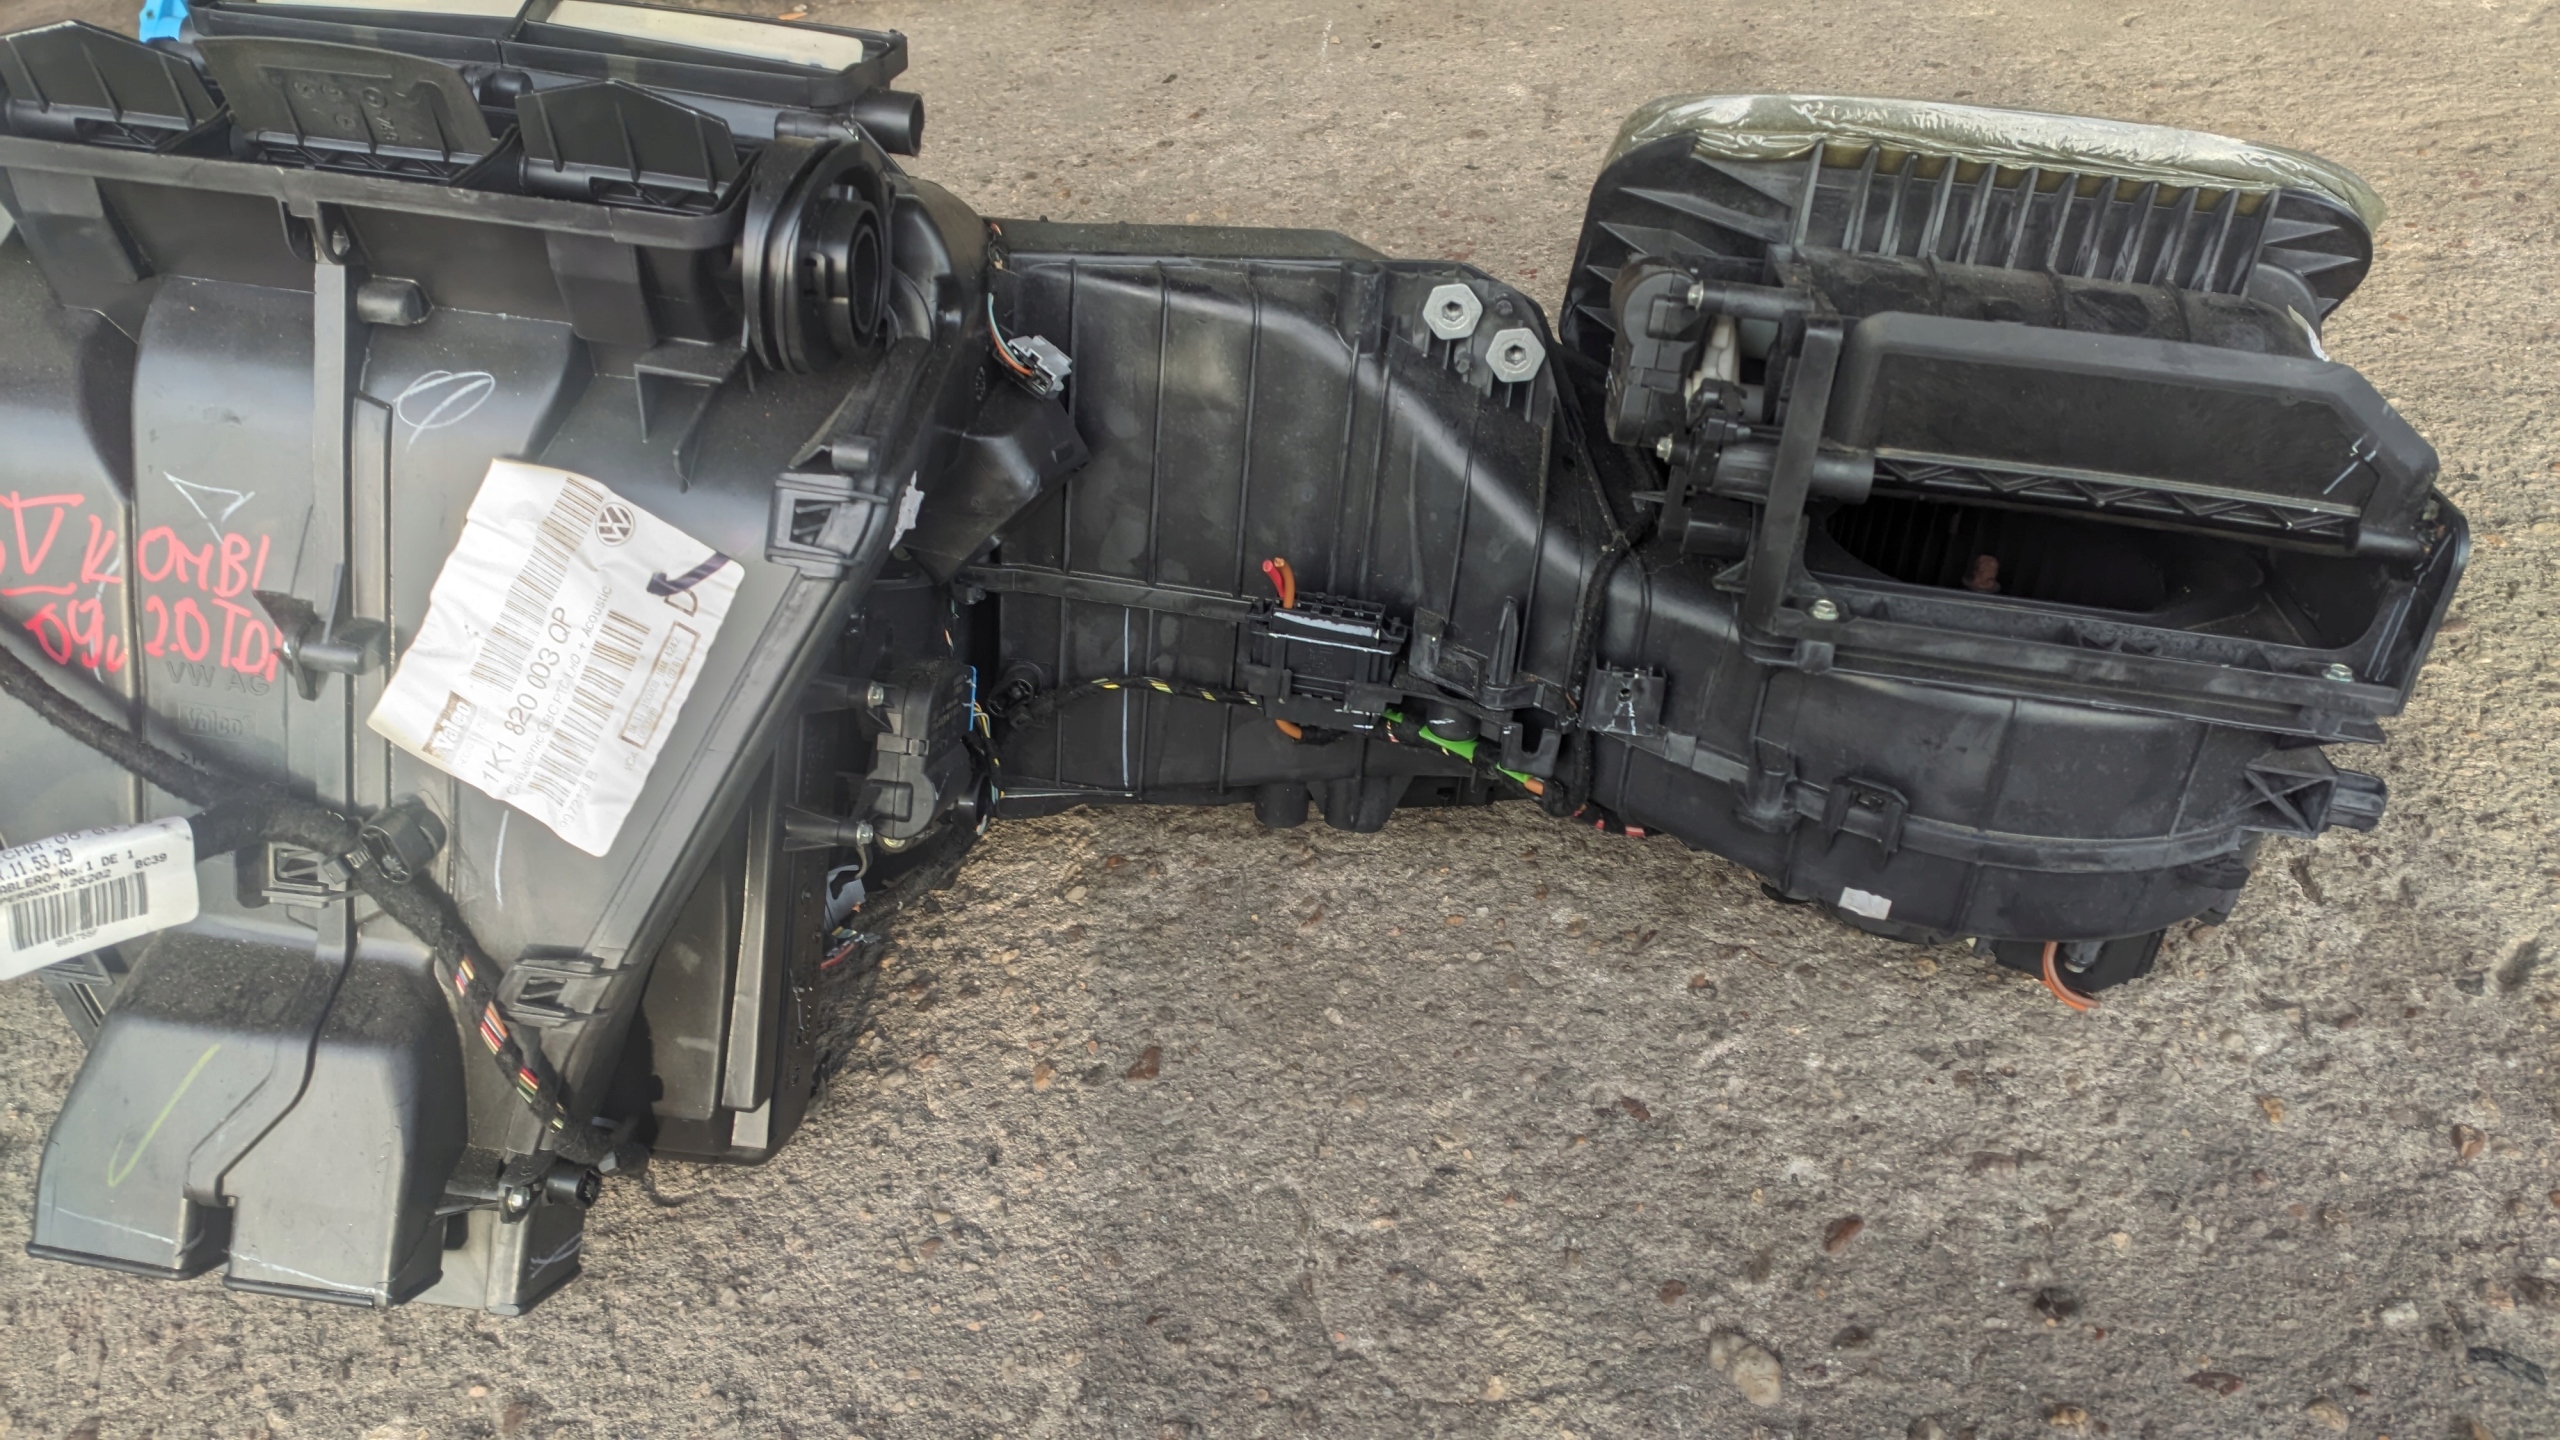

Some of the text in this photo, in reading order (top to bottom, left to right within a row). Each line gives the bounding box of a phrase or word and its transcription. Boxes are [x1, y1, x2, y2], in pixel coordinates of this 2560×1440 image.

[81, 514, 270, 598] KOMBI
[144, 595, 210, 662] 2.0
[212, 597, 283, 682] TDI
[535, 702, 560, 734] GBC
[551, 678, 572, 704] PTC
[580, 584, 612, 637] Acoustic
[166, 660, 270, 697] VW AG
[482, 605, 573, 783] 1K1 820 003 QP
[430, 700, 472, 750] Valeo
[585, 769, 598, 782] B
[0, 847, 74, 881] .11.53.29
[101, 853, 118, 867] DE
